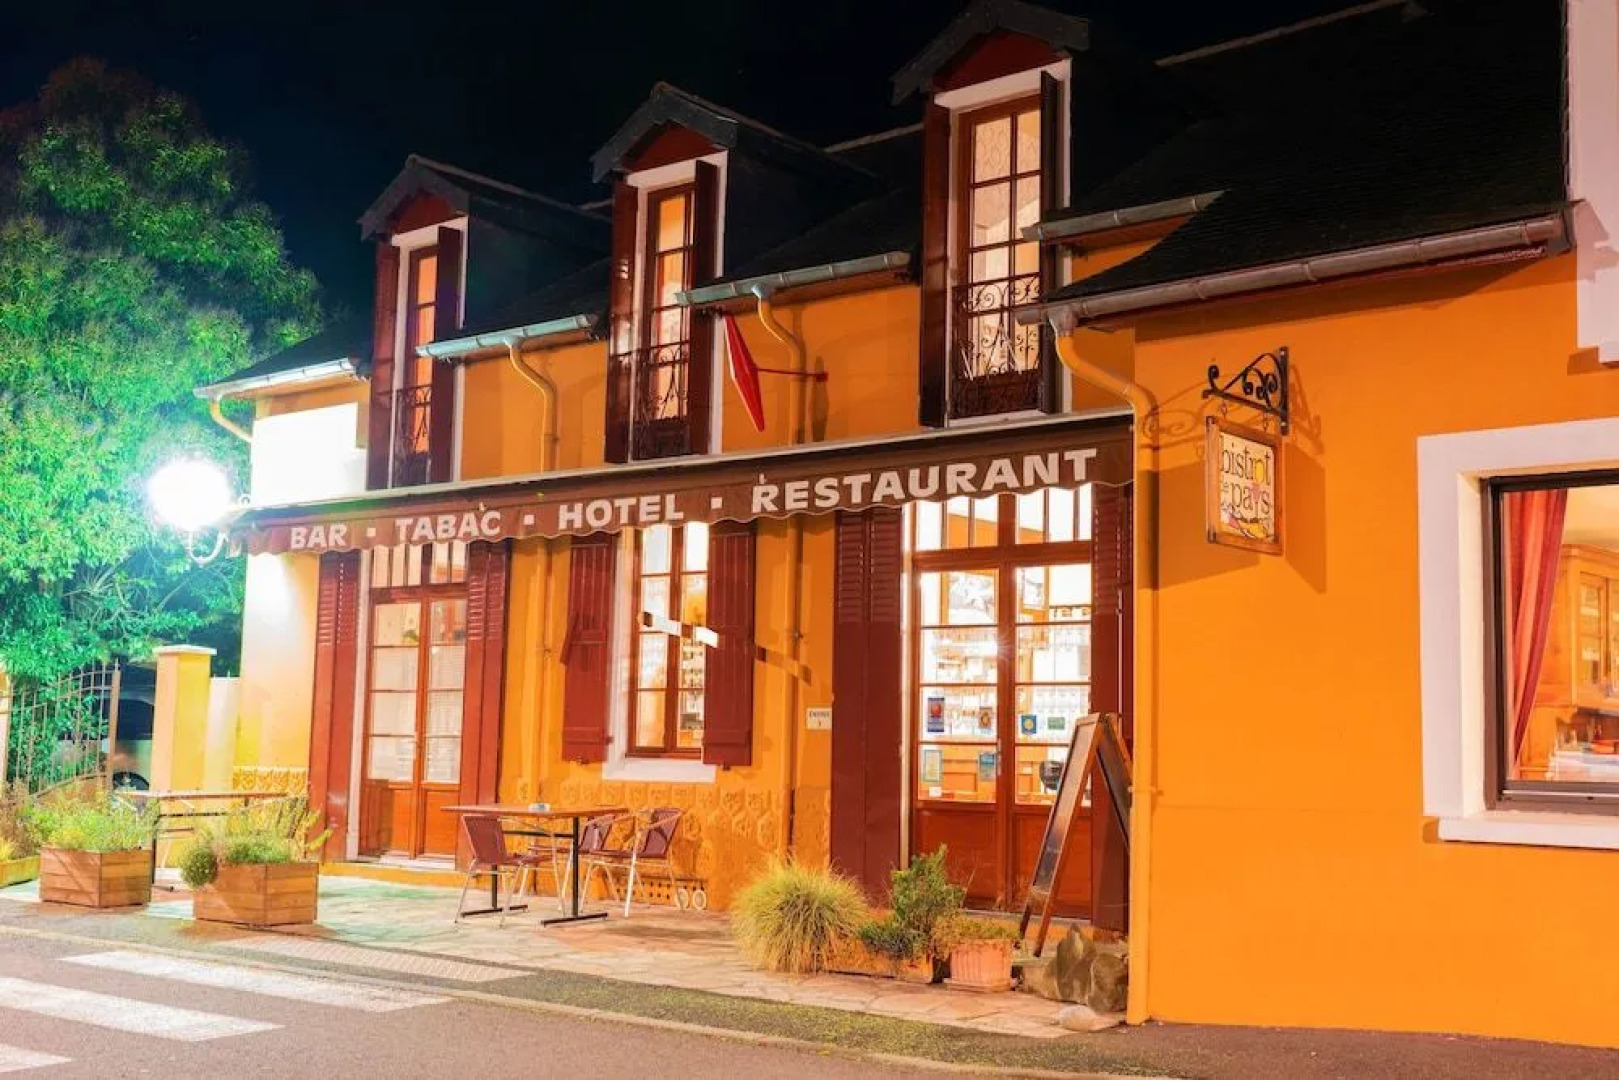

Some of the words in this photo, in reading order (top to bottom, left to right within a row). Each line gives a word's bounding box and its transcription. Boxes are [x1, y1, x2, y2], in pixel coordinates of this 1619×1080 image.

[1220, 436, 1270, 485] bistrot
[290, 524, 348, 550] BAR
[395, 511, 501, 543] TABAC
[558, 494, 684, 531] HOTEL
[751, 448, 1097, 513] RESTAURANT
[1231, 483, 1270, 519] pays
